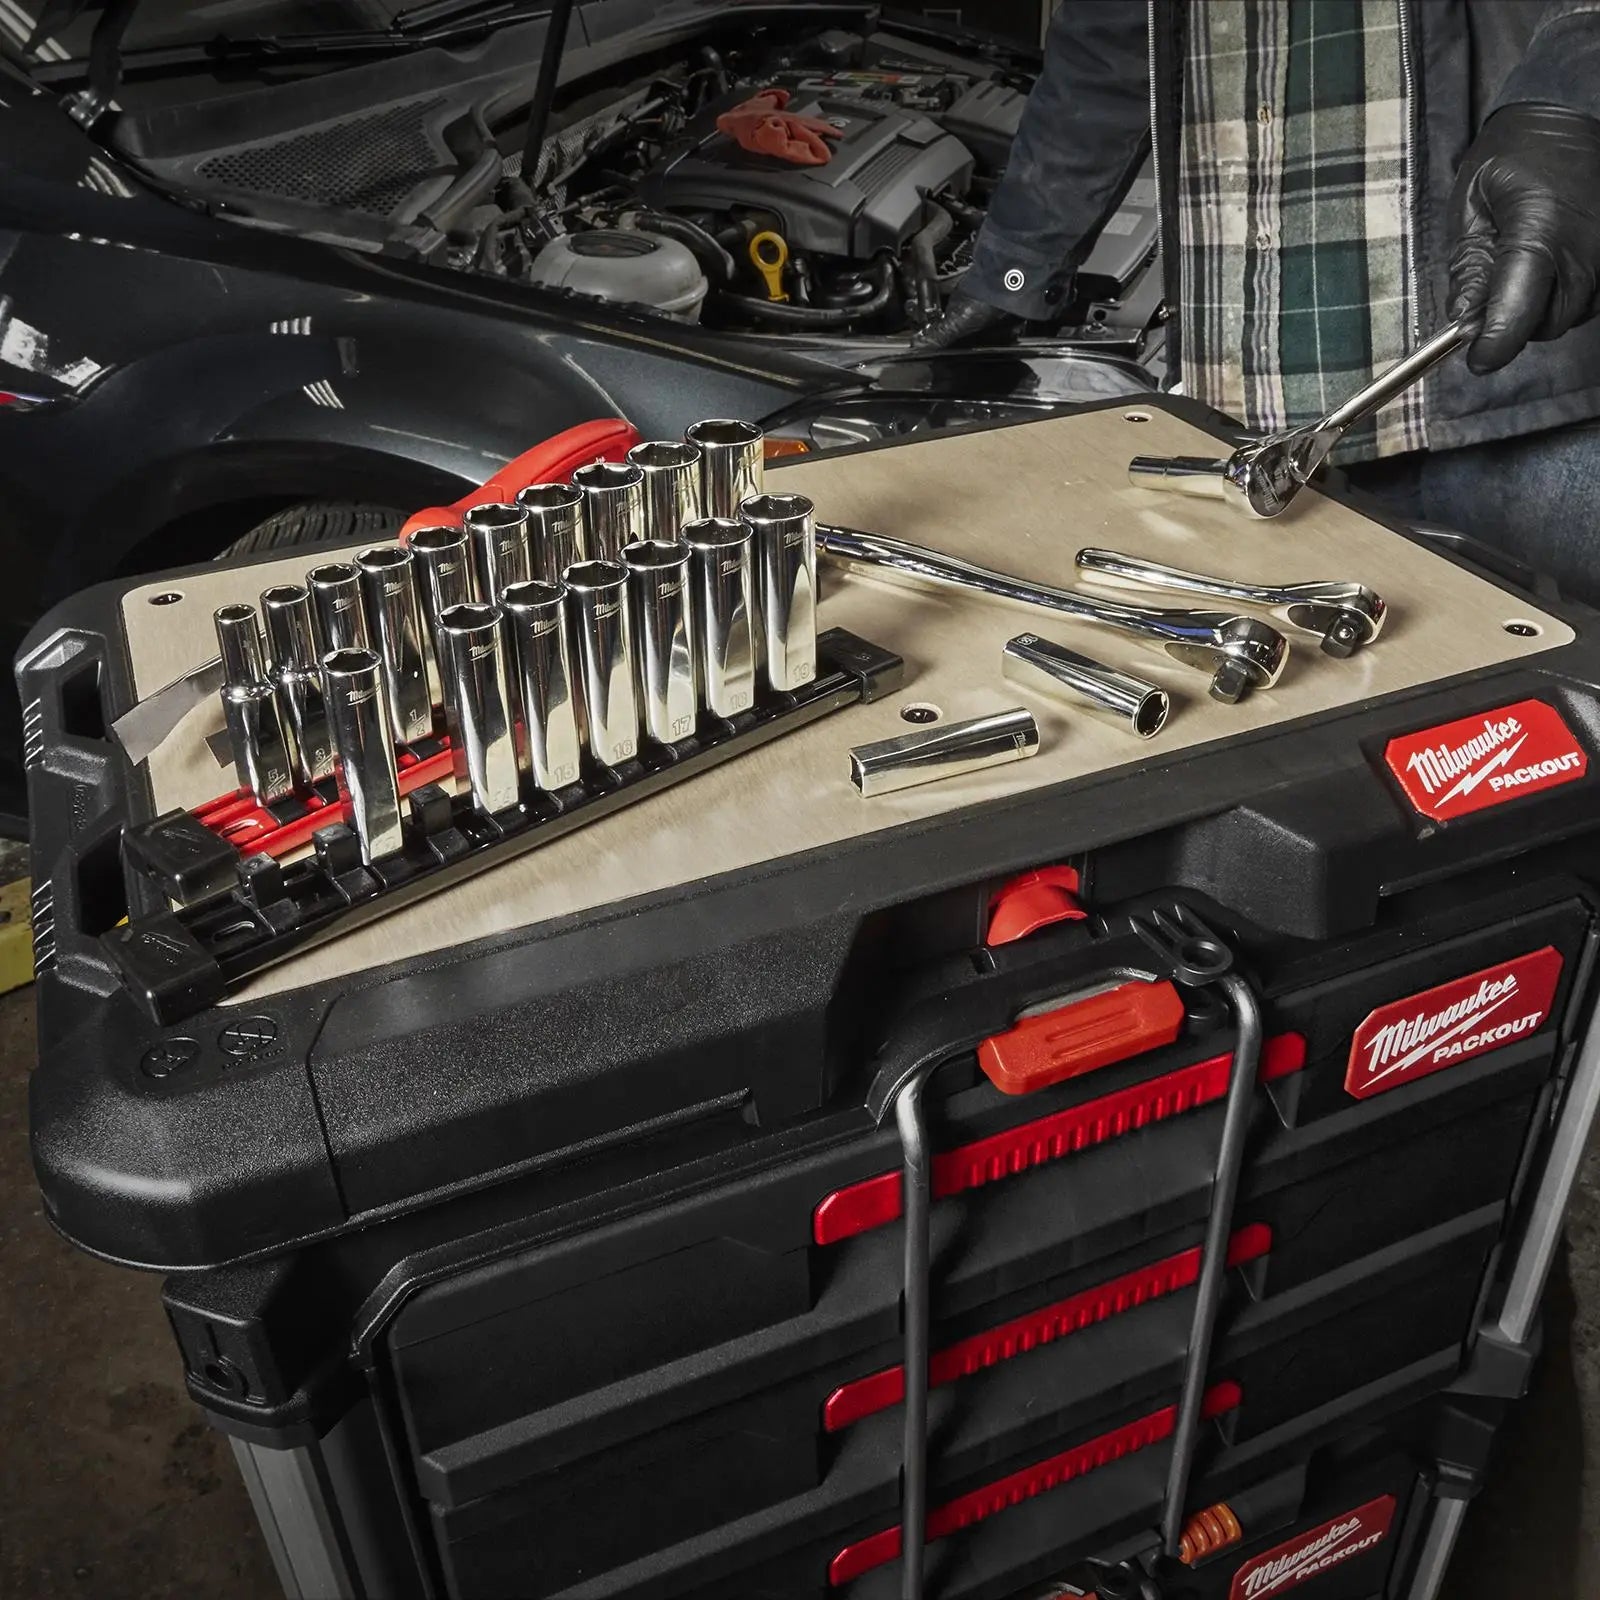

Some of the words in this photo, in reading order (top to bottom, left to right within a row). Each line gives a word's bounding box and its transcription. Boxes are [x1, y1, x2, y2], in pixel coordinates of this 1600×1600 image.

[613, 739, 634, 760] 16
[672, 715, 692, 737] 17
[1406, 717, 1522, 794] Milwaukee
[1488, 752, 1581, 792] PACKOUT
[1364, 974, 1516, 1072] Milwaukee
[1432, 1011, 1543, 1063] PACKOUT
[1241, 1517, 1361, 1597] Milwaukee
[1296, 1531, 1383, 1580] PACKOUT
